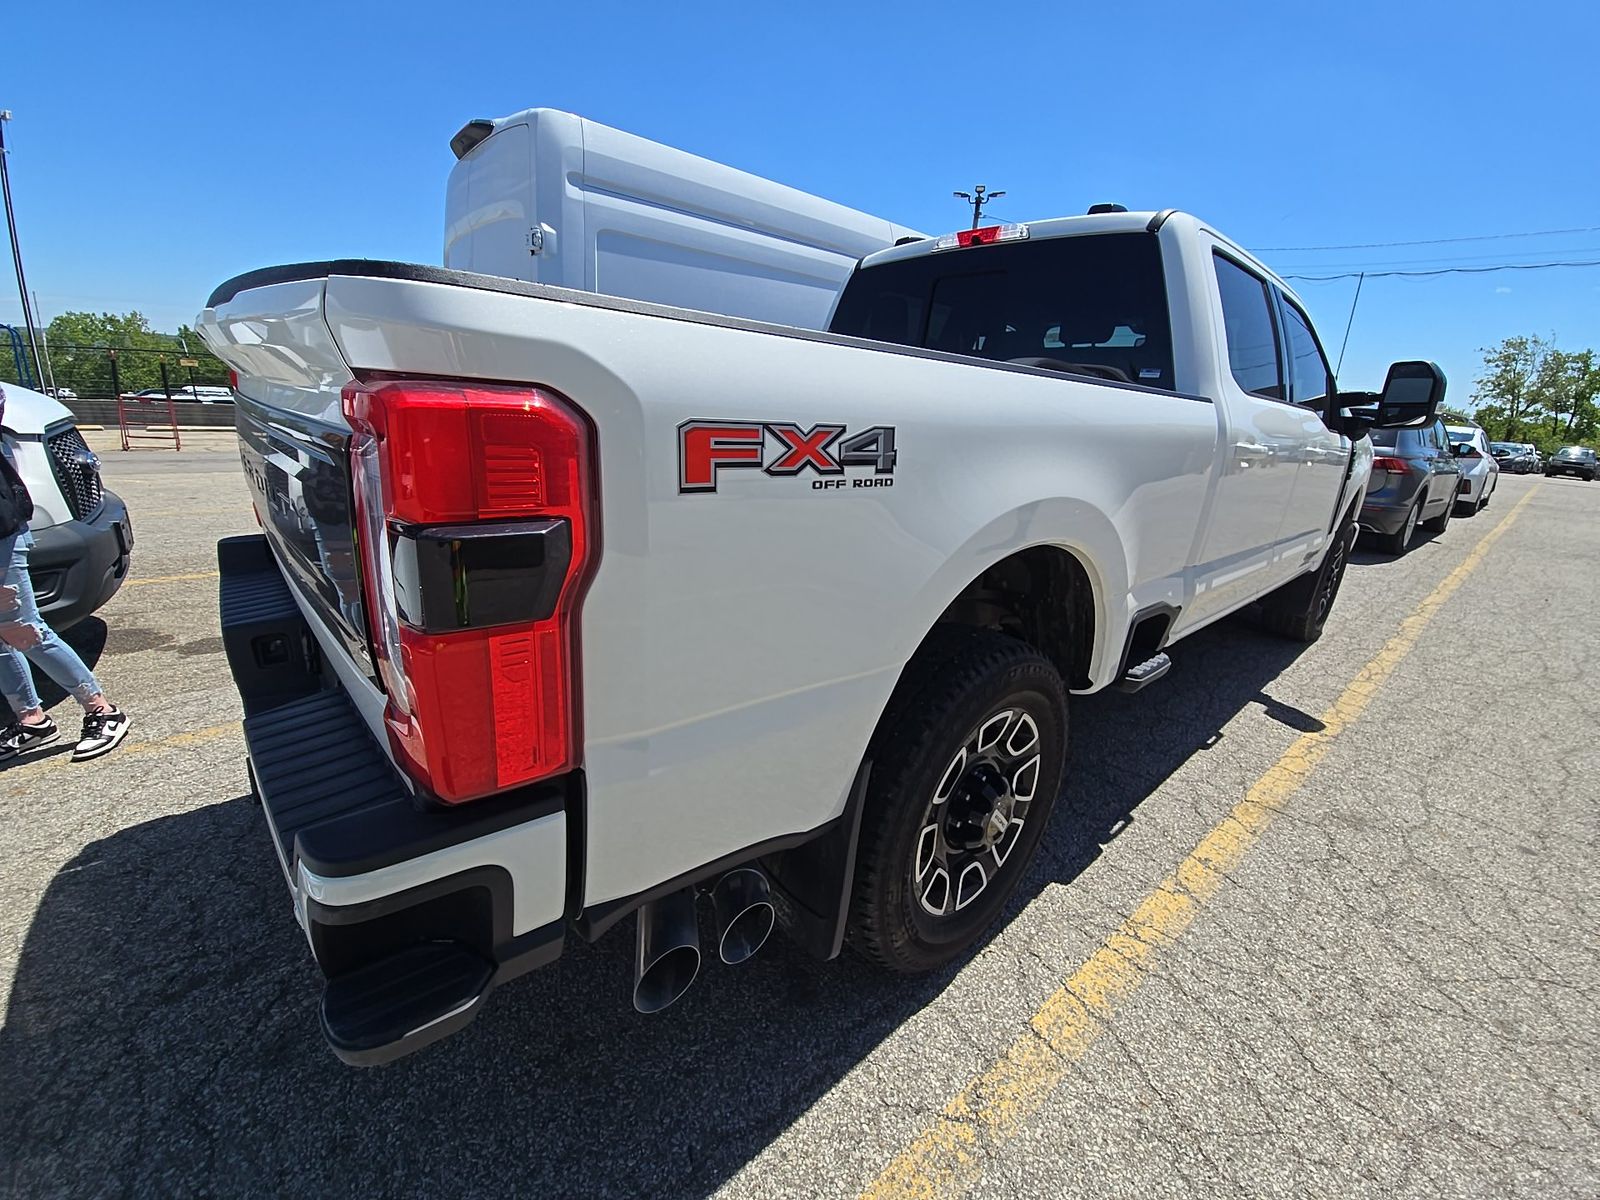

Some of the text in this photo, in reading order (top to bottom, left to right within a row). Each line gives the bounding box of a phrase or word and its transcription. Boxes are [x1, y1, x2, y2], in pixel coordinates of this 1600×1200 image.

[679, 419, 896, 494] FX4
[811, 478, 894, 490] OFF ROAD
